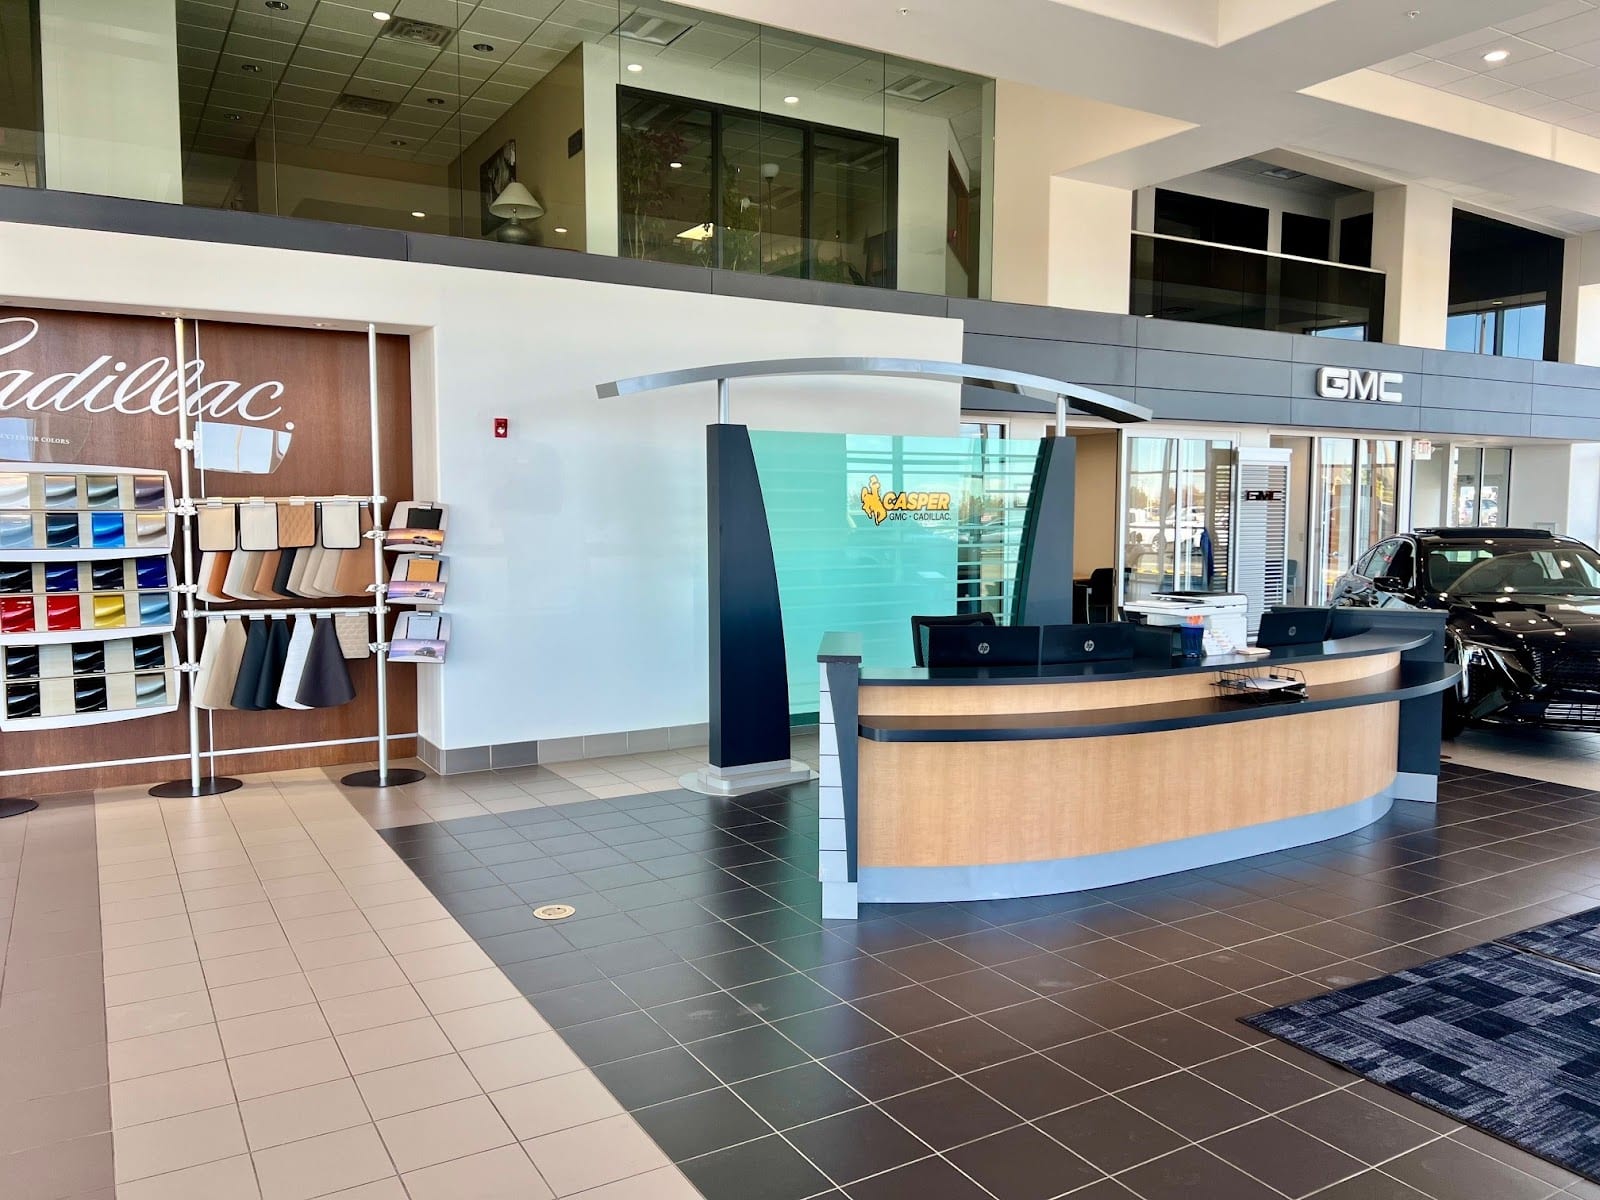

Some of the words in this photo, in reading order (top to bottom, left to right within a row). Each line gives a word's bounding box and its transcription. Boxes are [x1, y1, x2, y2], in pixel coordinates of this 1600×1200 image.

[1315, 367, 1403, 403] GMC
[41, 436, 70, 445] COLORS
[883, 491, 950, 511] CASPER
[1245, 490, 1282, 501] GMC
[889, 512, 907, 521] GMC
